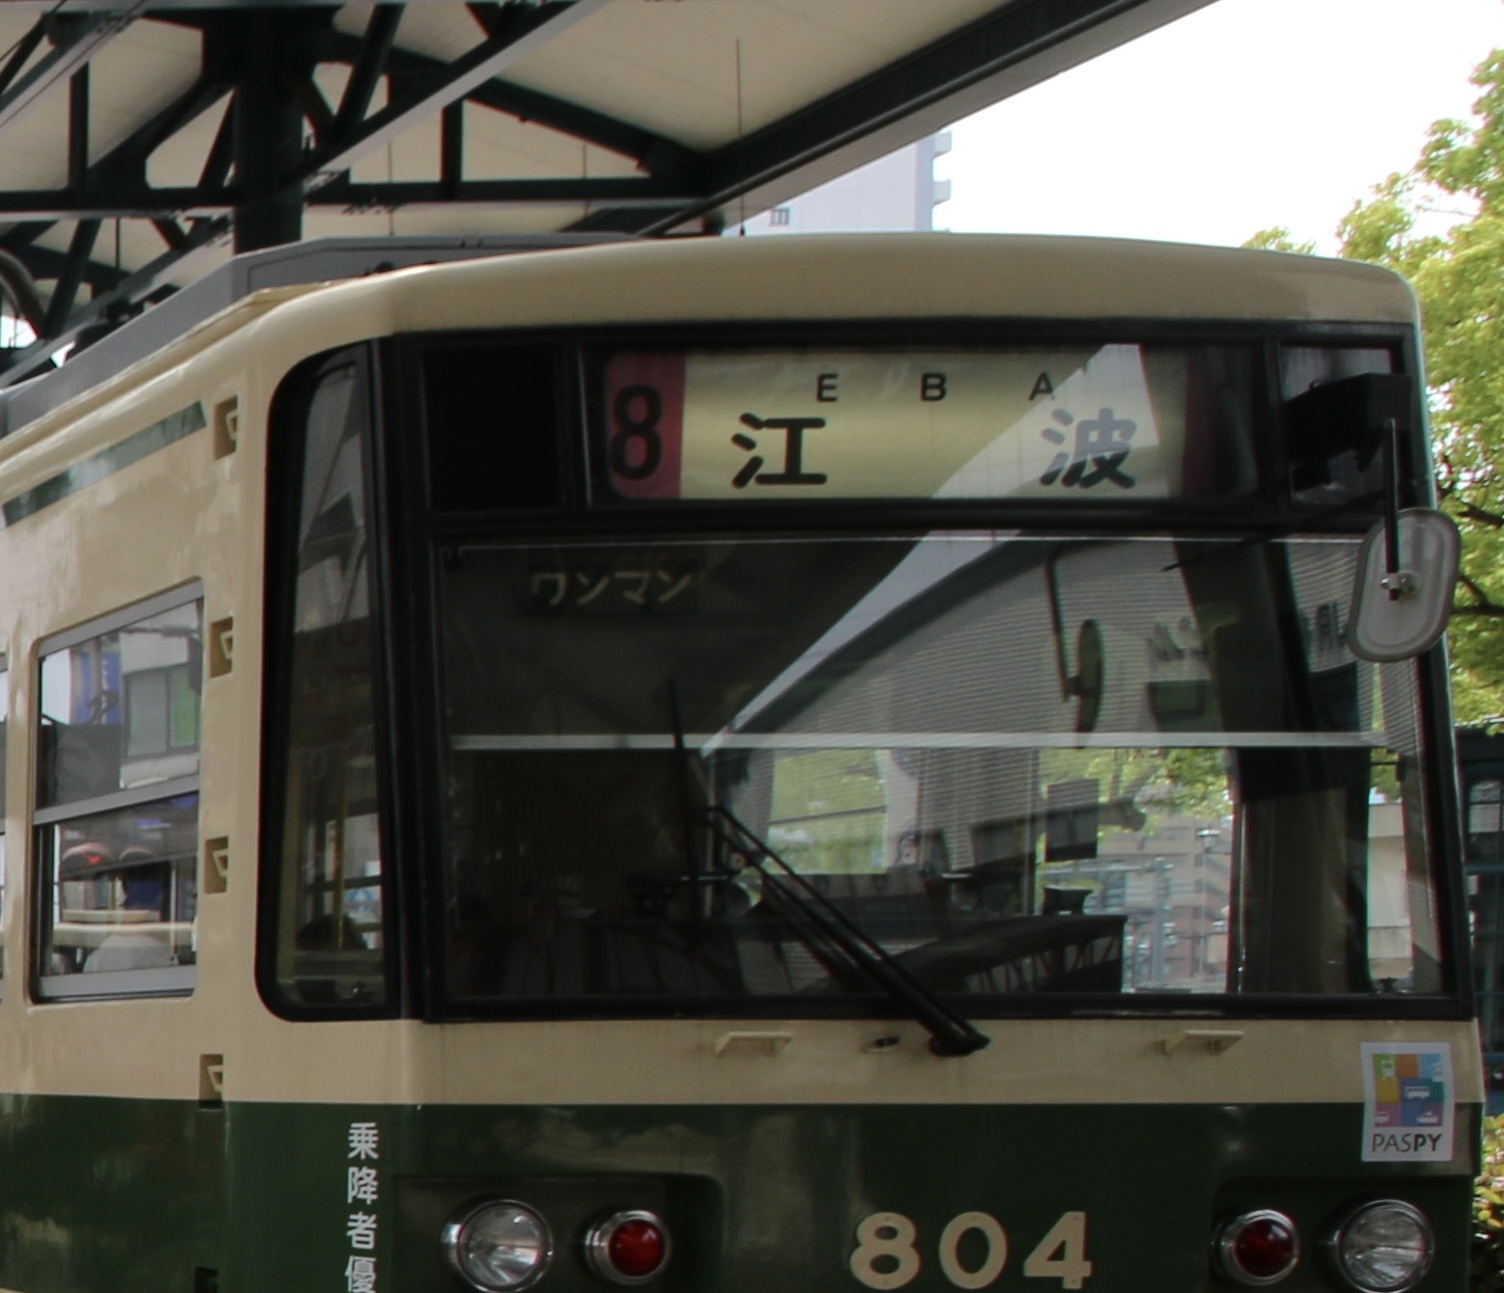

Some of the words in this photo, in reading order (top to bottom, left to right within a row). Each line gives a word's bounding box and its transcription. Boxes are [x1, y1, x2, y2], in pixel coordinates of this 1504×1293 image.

[609, 384, 665, 481] 8
[730, 408, 1137, 490] 江波
[530, 569, 699, 607] ワンマン
[1371, 1132, 1443, 1154] PASPY
[849, 1211, 1093, 1291] 804
